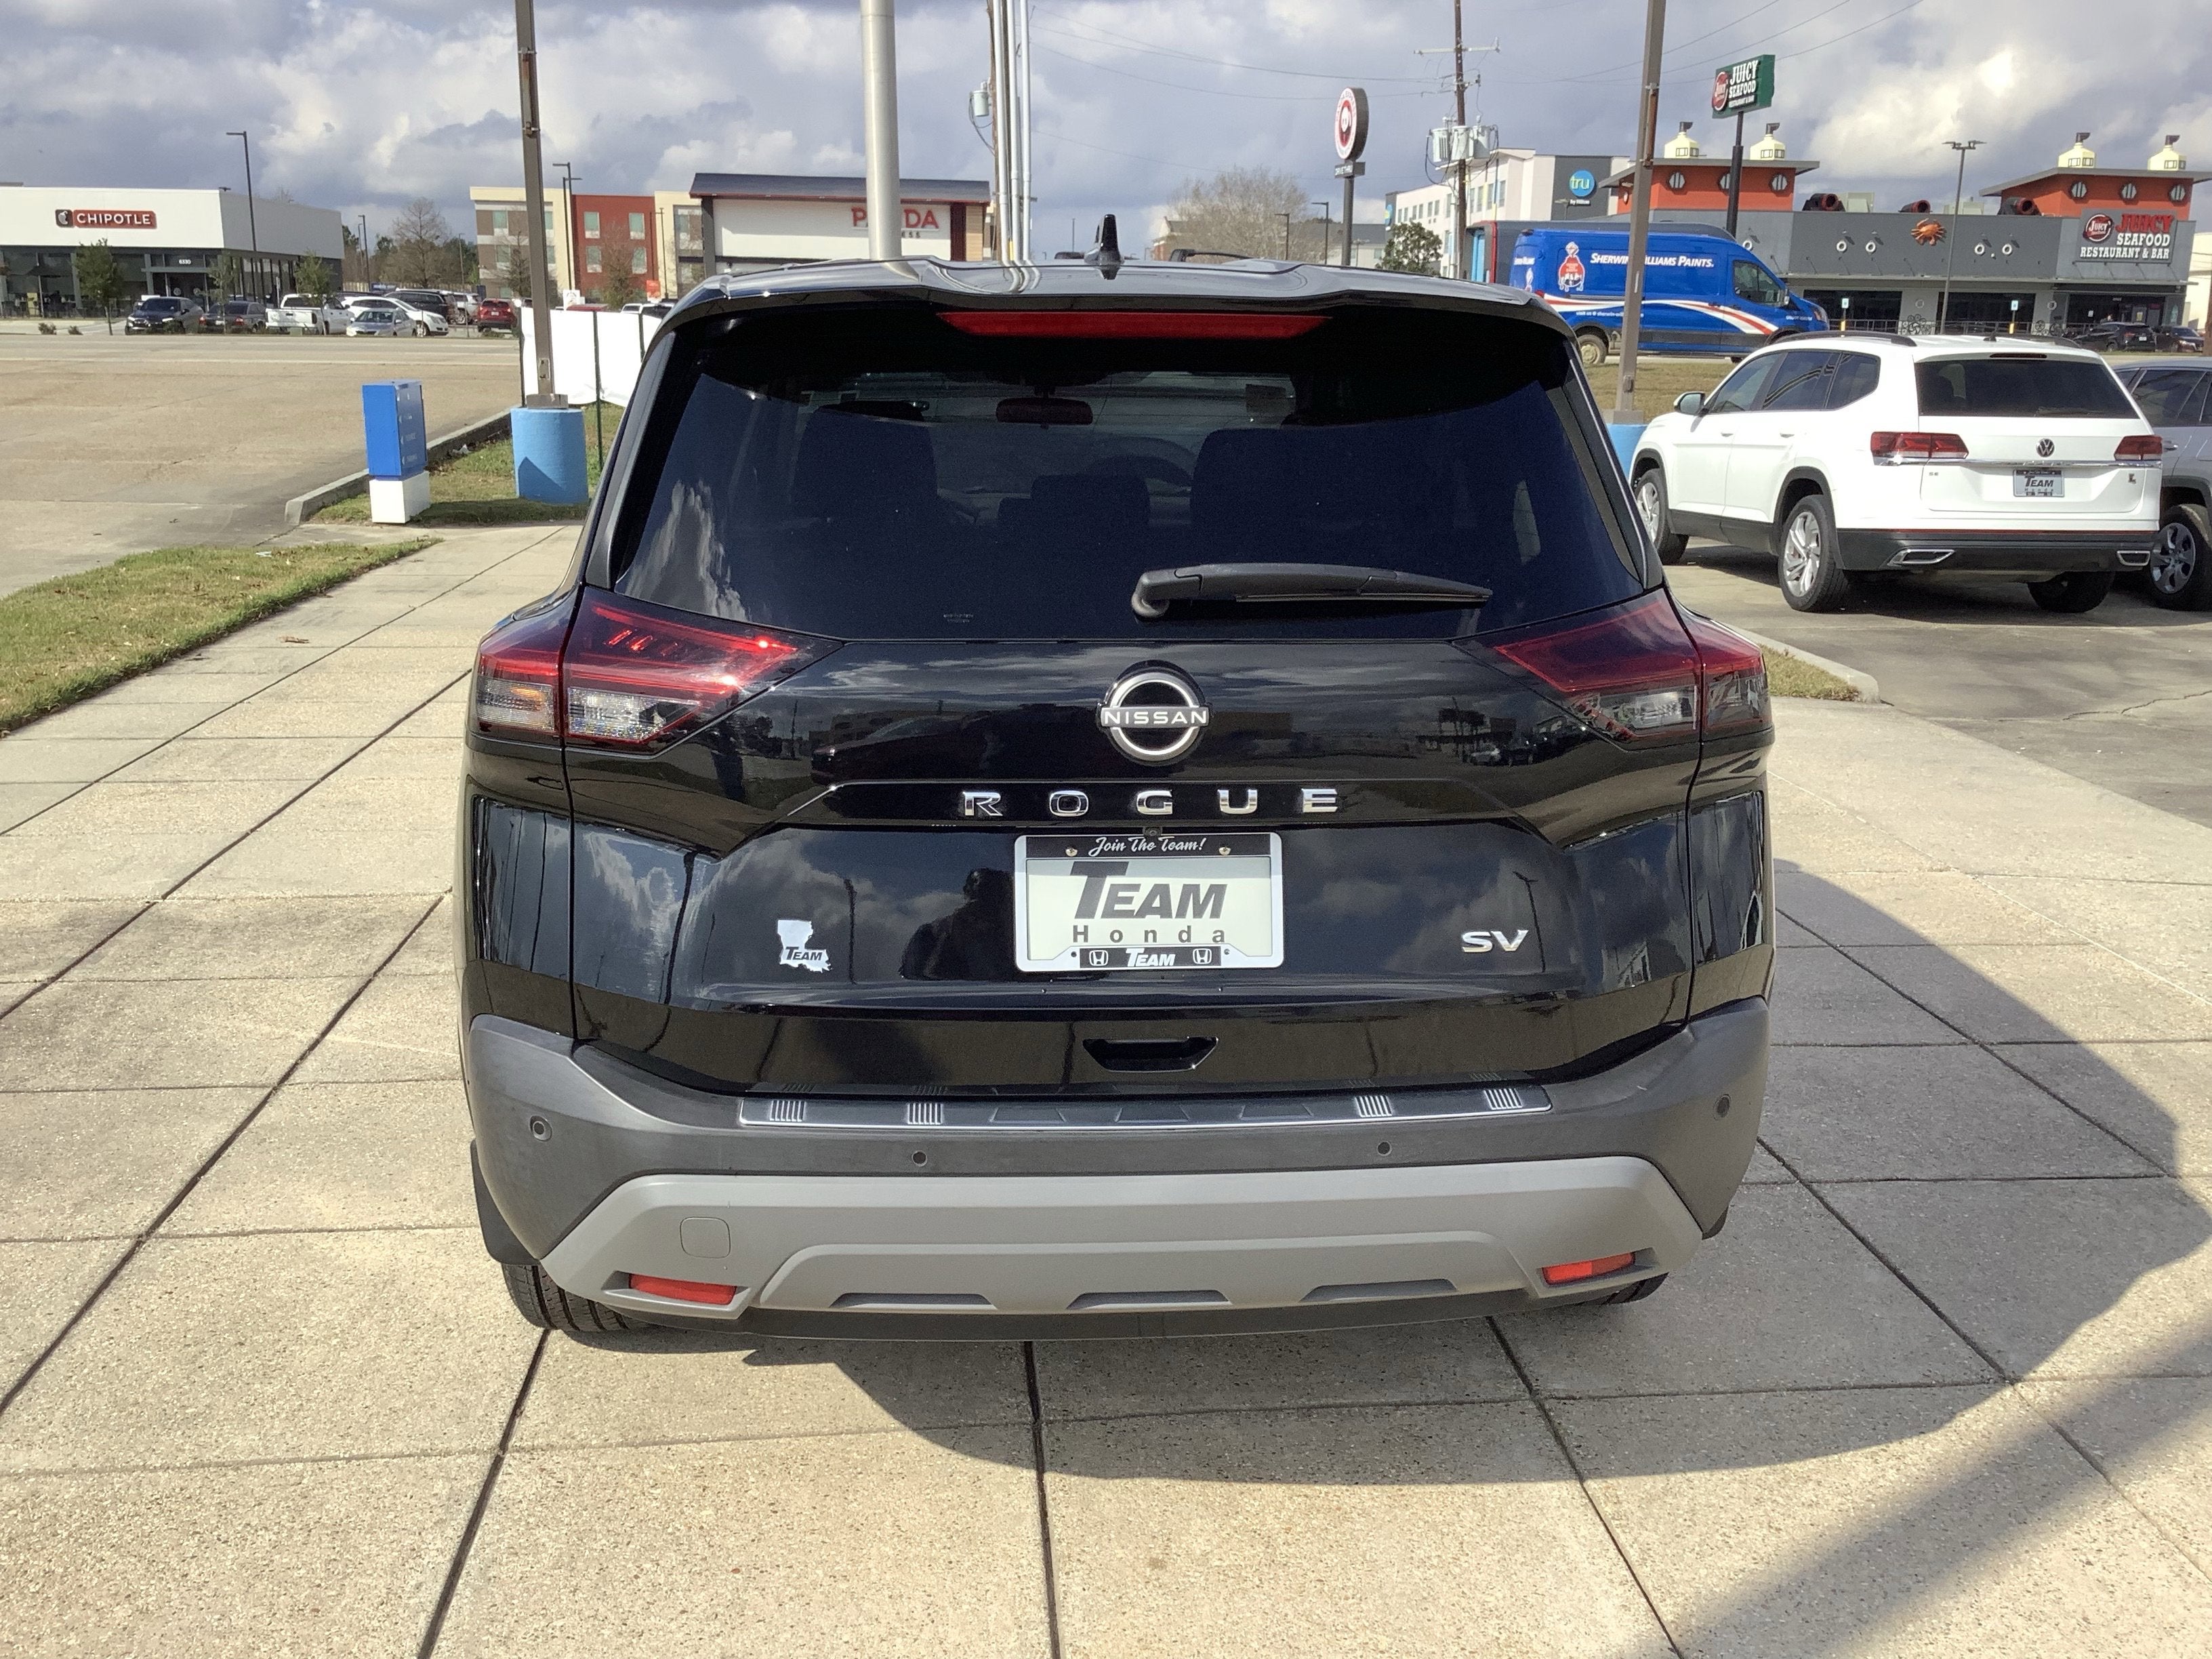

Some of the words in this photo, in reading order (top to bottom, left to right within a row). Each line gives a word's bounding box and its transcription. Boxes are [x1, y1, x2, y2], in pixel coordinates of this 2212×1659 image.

[1729, 60, 1759, 85] JUICY
[1728, 80, 1757, 99] SEAFOOD
[1572, 176, 1590, 189] tru
[77, 213, 151, 225] CHIPOTLE
[851, 207, 939, 229] PDA
[2089, 220, 2108, 231] JUICY
[2114, 213, 2174, 233] JUICY
[2116, 232, 2171, 247] SEAFOOD
[2080, 246, 2141, 258] RESTAURANT
[2142, 248, 2150, 259] &
[2150, 248, 2170, 260] BAR
[2024, 476, 2054, 487] TEAM
[1104, 710, 1207, 724] NISSAN
[962, 788, 1338, 817] ROGUE
[1088, 836, 1126, 857] Join
[1128, 836, 1156, 853] The
[1158, 836, 1207, 852] Team!
[1069, 861, 1228, 920] TEAM
[1073, 924, 1225, 943] Honda
[1462, 929, 1530, 953] SV
[785, 946, 823, 961] TEAM
[1126, 948, 1176, 967] TEAM
